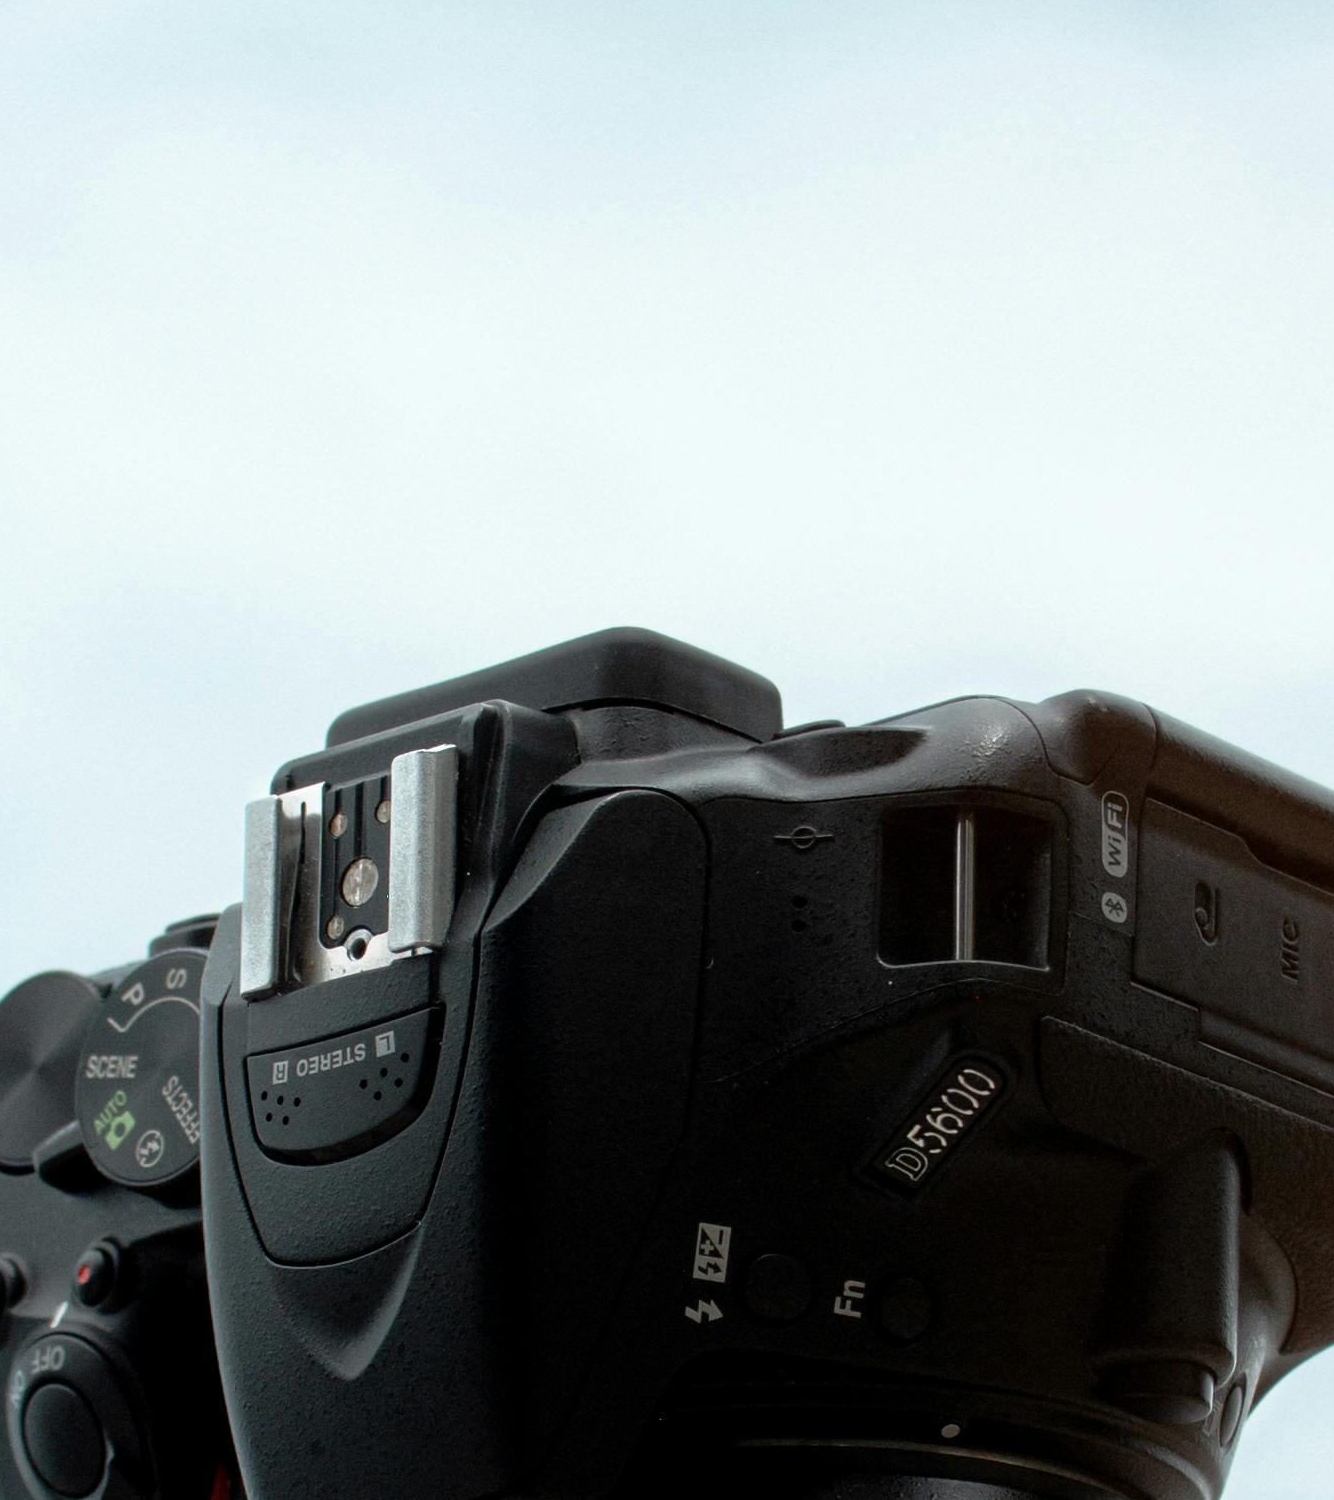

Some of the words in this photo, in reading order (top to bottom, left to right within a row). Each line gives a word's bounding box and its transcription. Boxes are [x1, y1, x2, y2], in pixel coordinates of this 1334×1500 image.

[1281, 917, 1300, 982] MIC
[120, 981, 145, 1006] P
[166, 967, 187, 989] S
[85, 1055, 138, 1079] SCENE
[296, 1042, 366, 1077] STEREO
[93, 1090, 128, 1135] AUTO
[886, 1067, 998, 1183] D5600
[833, 1279, 866, 1318] Fn
[30, 1345, 65, 1372] OFF
